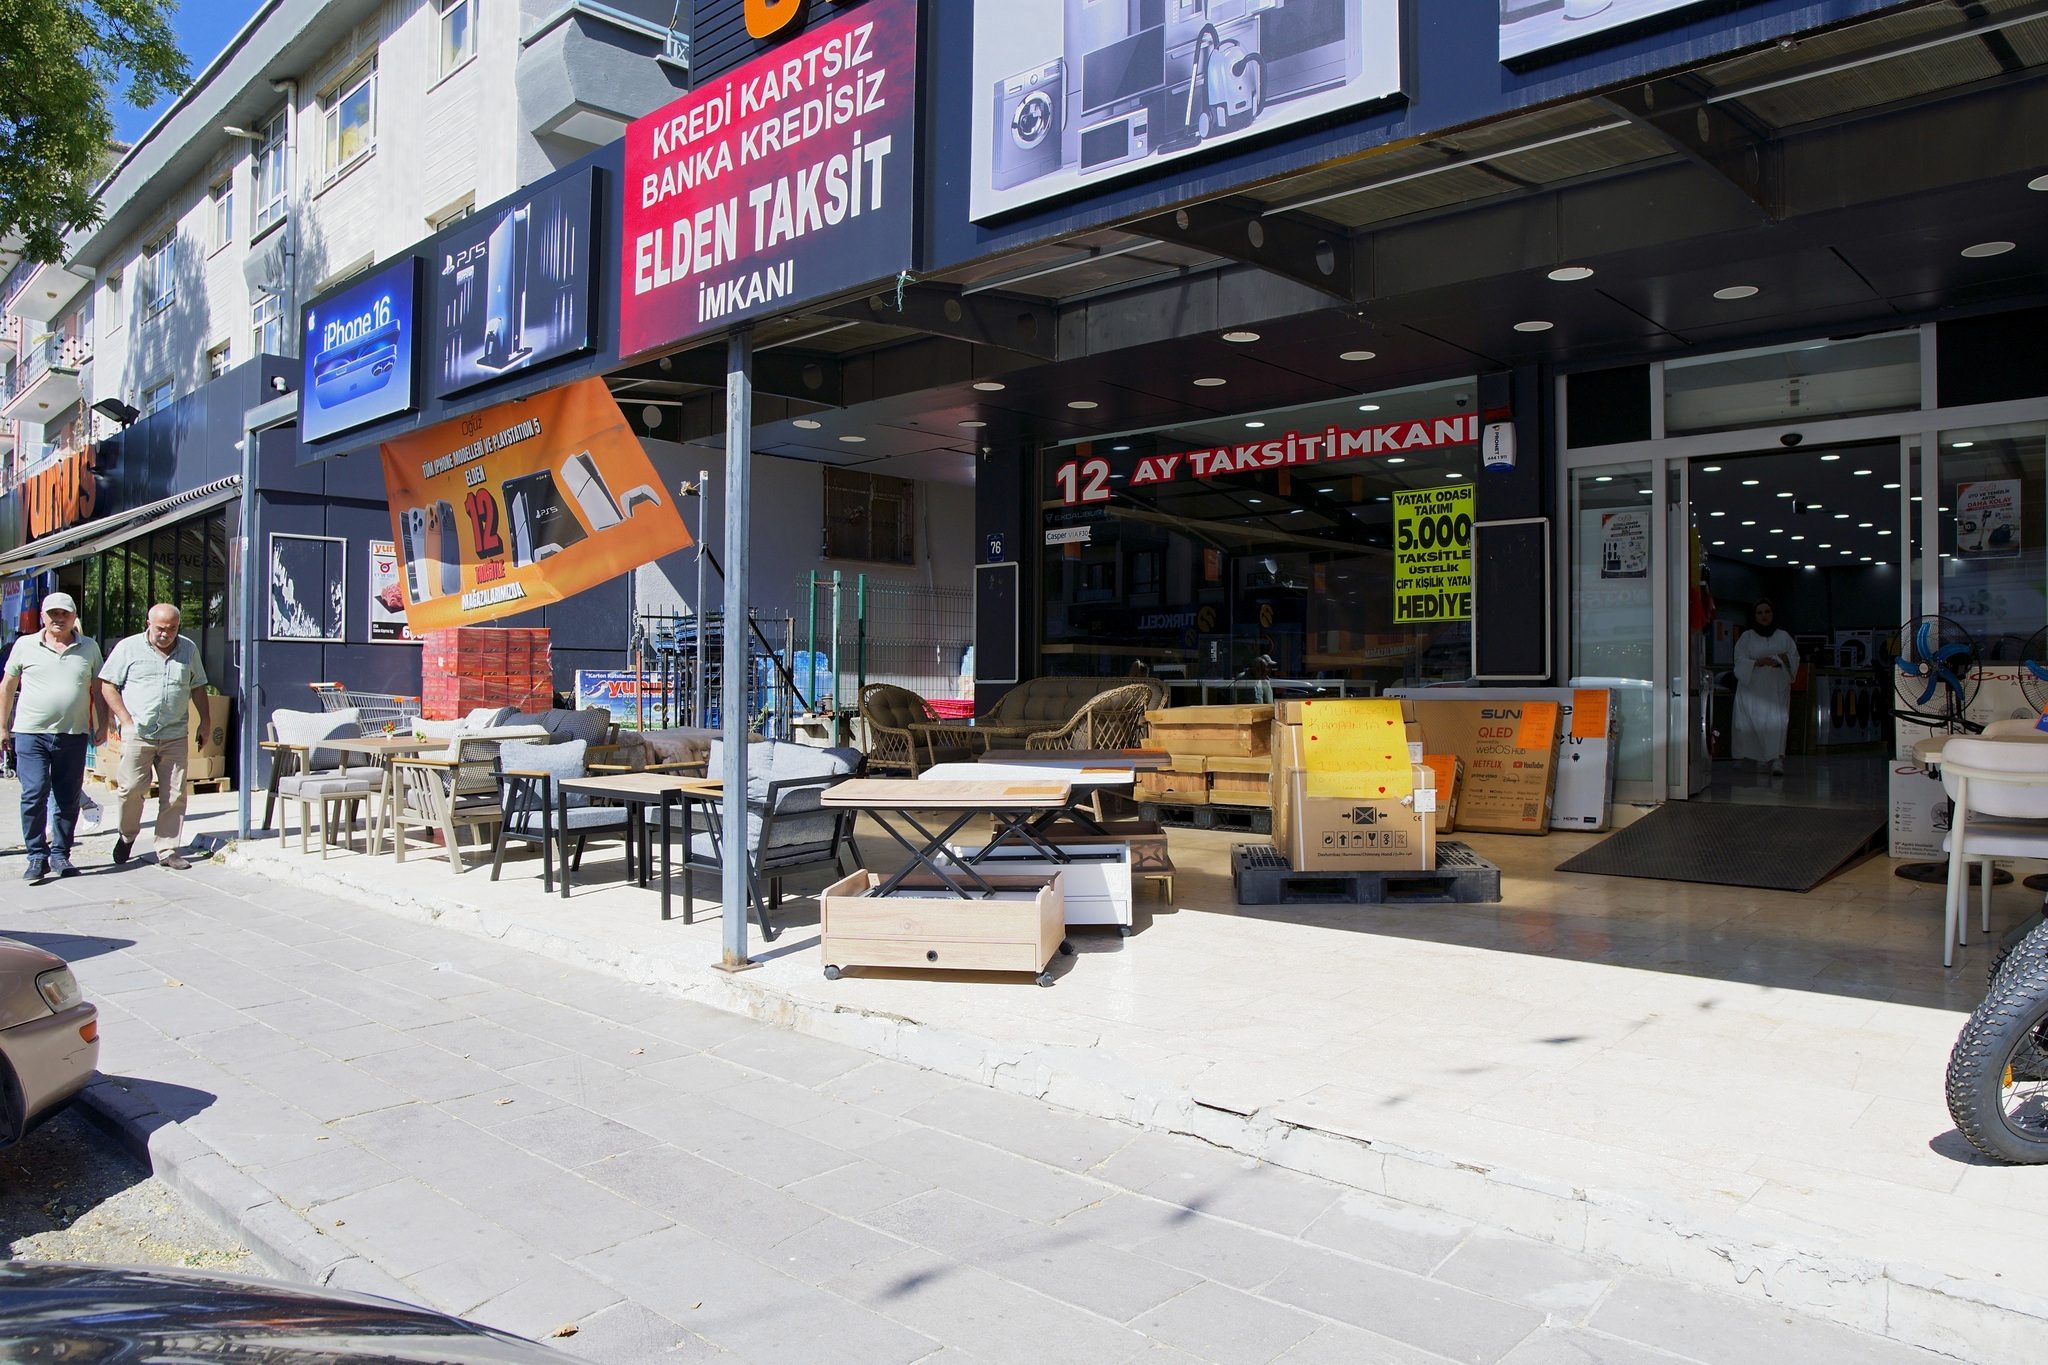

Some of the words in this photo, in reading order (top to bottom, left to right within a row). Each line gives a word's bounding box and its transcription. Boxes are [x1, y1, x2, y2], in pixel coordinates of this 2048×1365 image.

[652, 83, 731, 159] KREDİ
[741, 21, 873, 118] KARTSIZ
[642, 140, 733, 209] BANKA
[741, 69, 886, 166] KREDİSİZ
[635, 197, 737, 296] ELDEN
[749, 130, 892, 252] TAKSİT
[457, 241, 485, 267] PS5
[698, 260, 793, 323] İMKANI
[324, 312, 371, 352] iPhone
[373, 295, 390, 329] 16
[453, 438, 485, 466] MODELLERİ
[484, 437, 494, 454] VE
[493, 419, 535, 450] PLAYSTATION
[533, 417, 541, 434] 5
[465, 464, 486, 487] ELDEN
[1057, 460, 1109, 503] 12
[1134, 457, 1178, 482] AY
[1396, 492, 1432, 505] YATAK
[1989, 496, 2012, 505] KOLAY
[541, 506, 558, 516] PS5
[1055, 509, 1104, 521] EXCALIBUR
[1414, 503, 1453, 516] TAKIMI
[464, 488, 502, 557] 12
[1047, 532, 1067, 541] Casper
[990, 541, 1002, 554] 76
[1398, 549, 1471, 563] TAKSİTLE
[1408, 563, 1459, 575] ÜSTELİK
[1396, 577, 1414, 591] ÇİFT
[1415, 575, 1445, 590] KİŞİLİK
[462, 582, 526, 611] MAĞAZALARIMIZDA
[1397, 589, 1472, 619] HEDİYE
[1481, 709, 1522, 719] SUN
[1478, 727, 1513, 738] QLED
[1475, 744, 1510, 755] webOS
[1472, 760, 1503, 769] NETFLIX
[1523, 761, 1544, 769] YouTube
